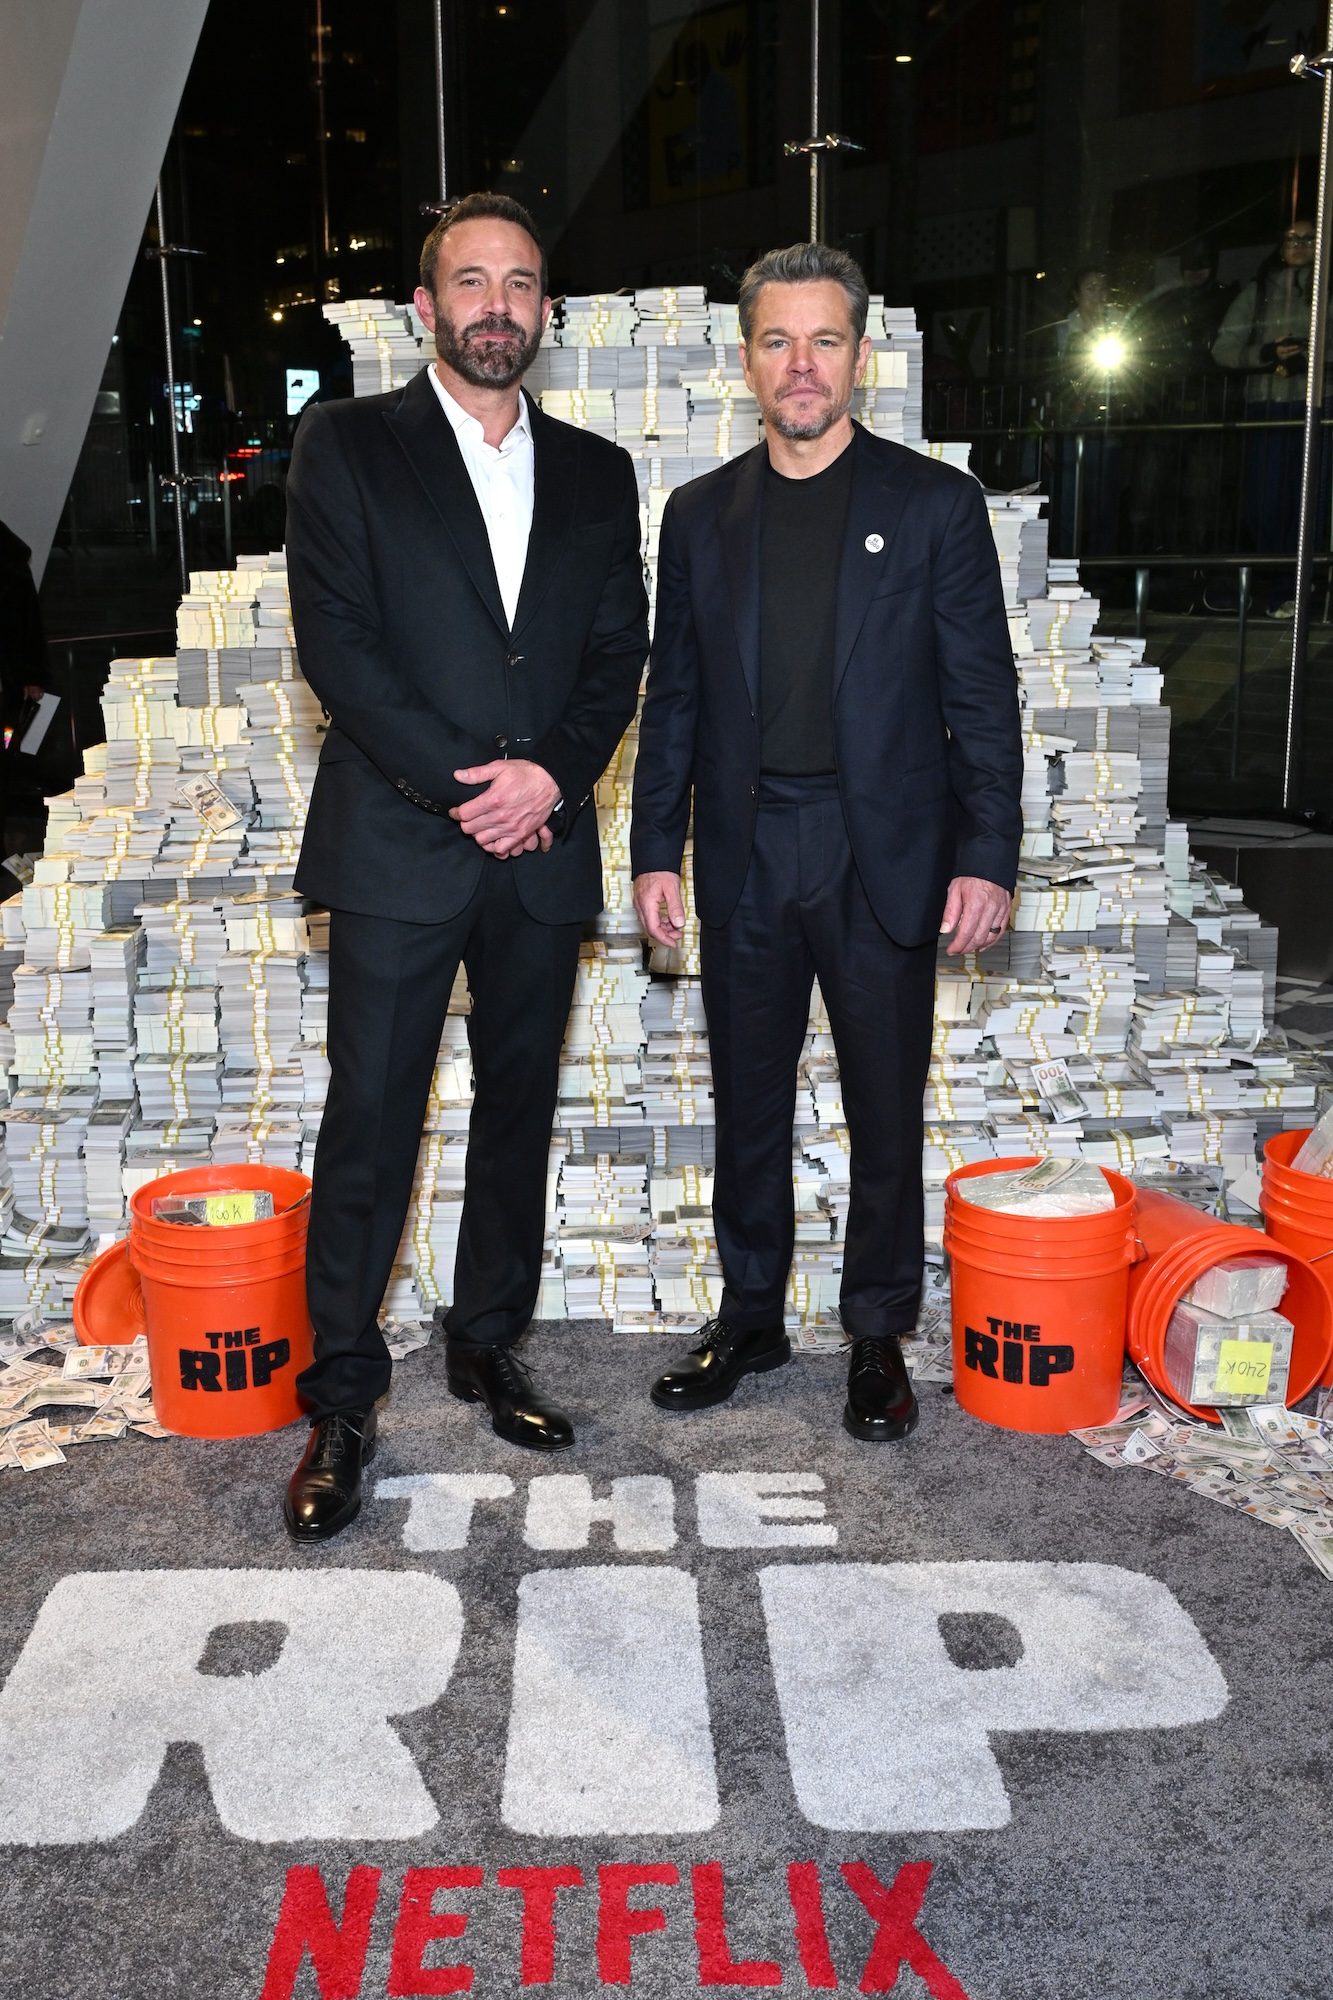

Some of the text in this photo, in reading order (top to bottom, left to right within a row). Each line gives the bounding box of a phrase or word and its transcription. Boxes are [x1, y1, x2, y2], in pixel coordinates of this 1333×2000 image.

[1038, 1065, 1064, 1080] 100
[205, 1327, 261, 1349] THE
[802, 1328, 817, 1345] 100
[986, 1316, 1041, 1342] THE
[179, 1338, 290, 1392] RIP
[965, 1325, 1075, 1387] RIP
[1224, 1360, 1267, 1378] 240K
[1081, 1431, 1102, 1446] 100
[1173, 1430, 1193, 1445] 100
[373, 1470, 839, 1553] THE
[0, 1559, 1231, 1846] RIP
[260, 1859, 970, 2000] NETFLIX
